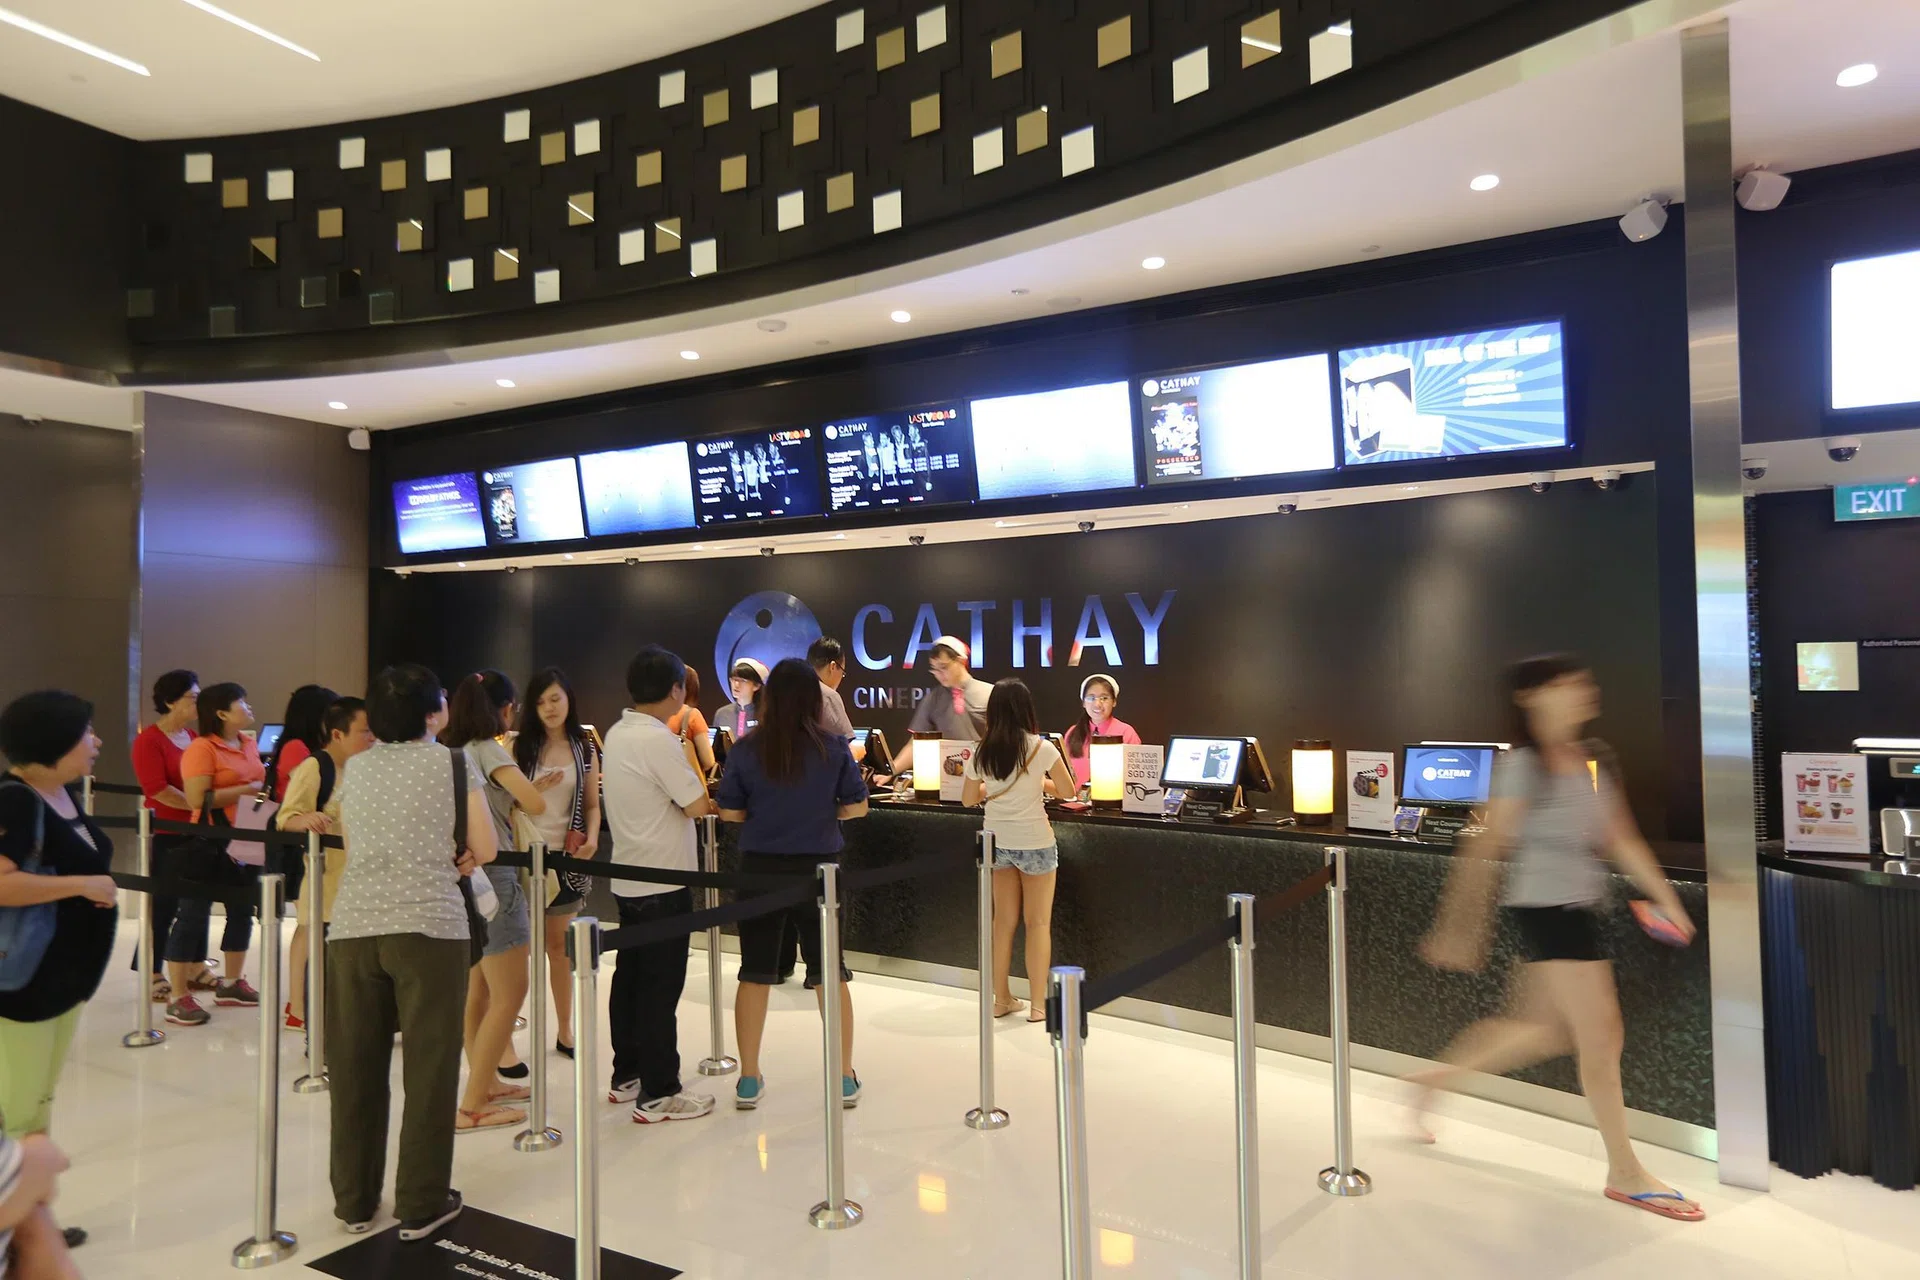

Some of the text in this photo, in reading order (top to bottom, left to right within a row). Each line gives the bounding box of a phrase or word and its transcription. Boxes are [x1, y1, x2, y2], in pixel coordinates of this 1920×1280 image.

[1160, 376, 1200, 389] CATHAY
[838, 422, 868, 434] CATHAY
[707, 440, 734, 452] CATHAY
[1851, 488, 1907, 513] EXIT
[851, 589, 1178, 670] CATHAY
[853, 686, 931, 709] CINEP
[1128, 770, 1145, 778] SGD
[1437, 768, 1472, 778] CATHAY
[1440, 820, 1463, 828] Counter
[469, 1249, 511, 1268] Tickets
[509, 1263, 561, 1280] Purcha
